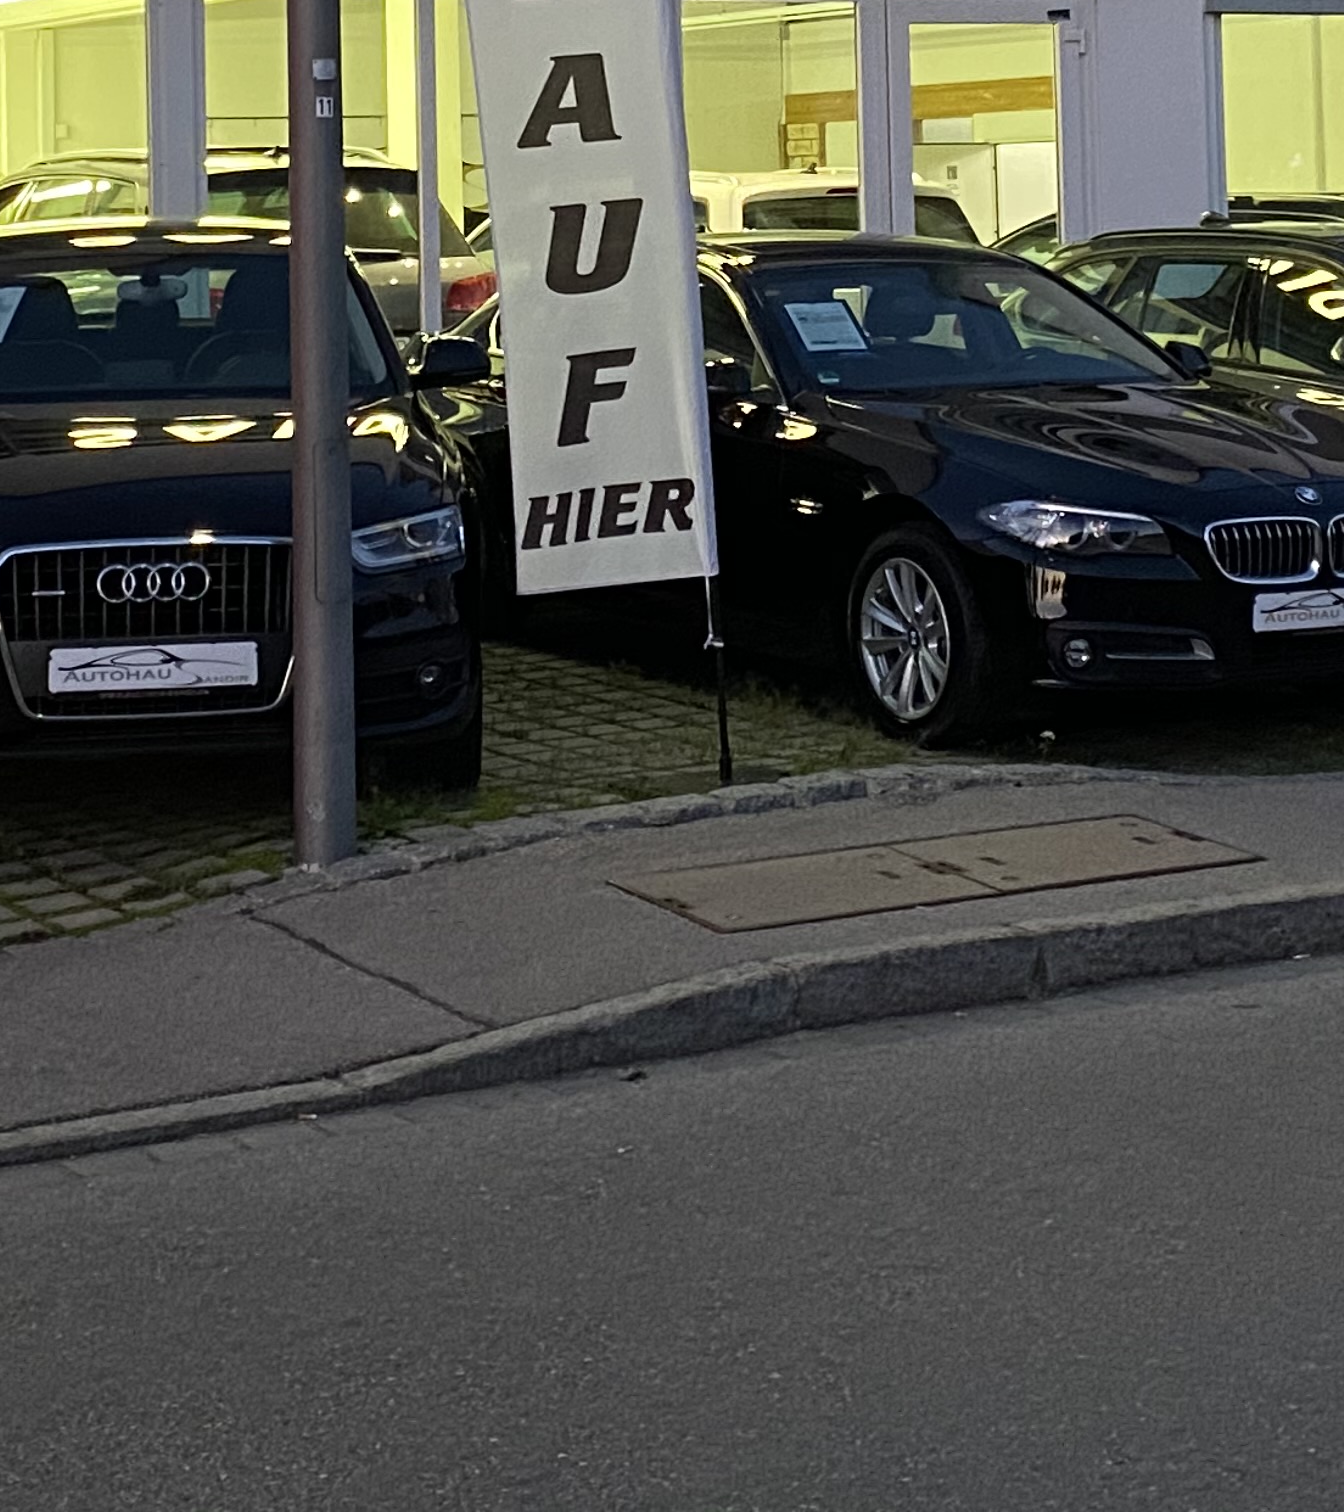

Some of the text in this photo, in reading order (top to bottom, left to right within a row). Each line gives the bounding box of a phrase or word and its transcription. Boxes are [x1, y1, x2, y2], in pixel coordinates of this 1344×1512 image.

[318, 98, 332, 115] 11
[521, 477, 697, 551] HIER
[63, 667, 173, 684] AUTOHAU
